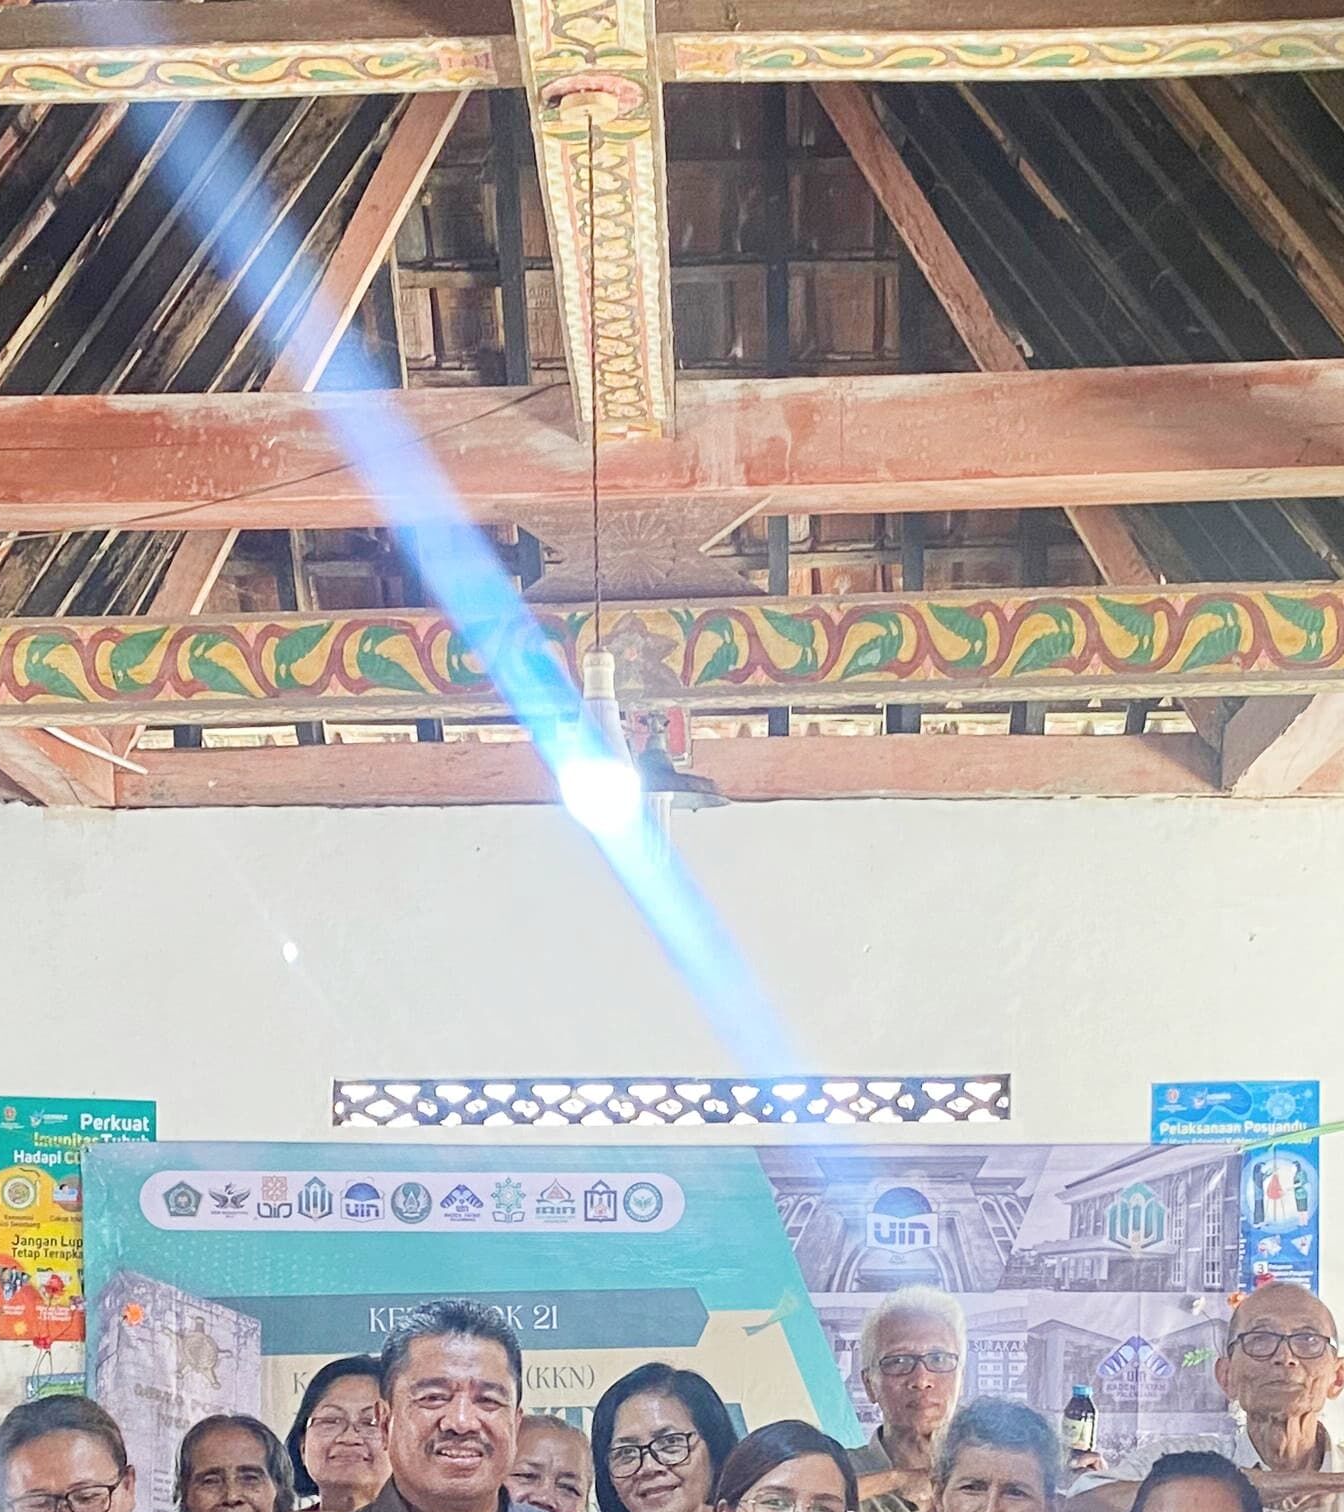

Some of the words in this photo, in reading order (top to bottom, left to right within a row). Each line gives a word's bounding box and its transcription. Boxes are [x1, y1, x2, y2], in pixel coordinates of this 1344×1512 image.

[80, 1113, 150, 1132] Perkuat
[1159, 1121, 1241, 1136] Pelaksanaan
[14, 1150, 62, 1167] Hadapi
[11, 1234, 58, 1250] Jangan
[61, 1235, 83, 1250] Lup
[11, 1248, 41, 1260] Tetap
[44, 1249, 83, 1261] Terapka
[525, 1365, 596, 1390] (KKN)
